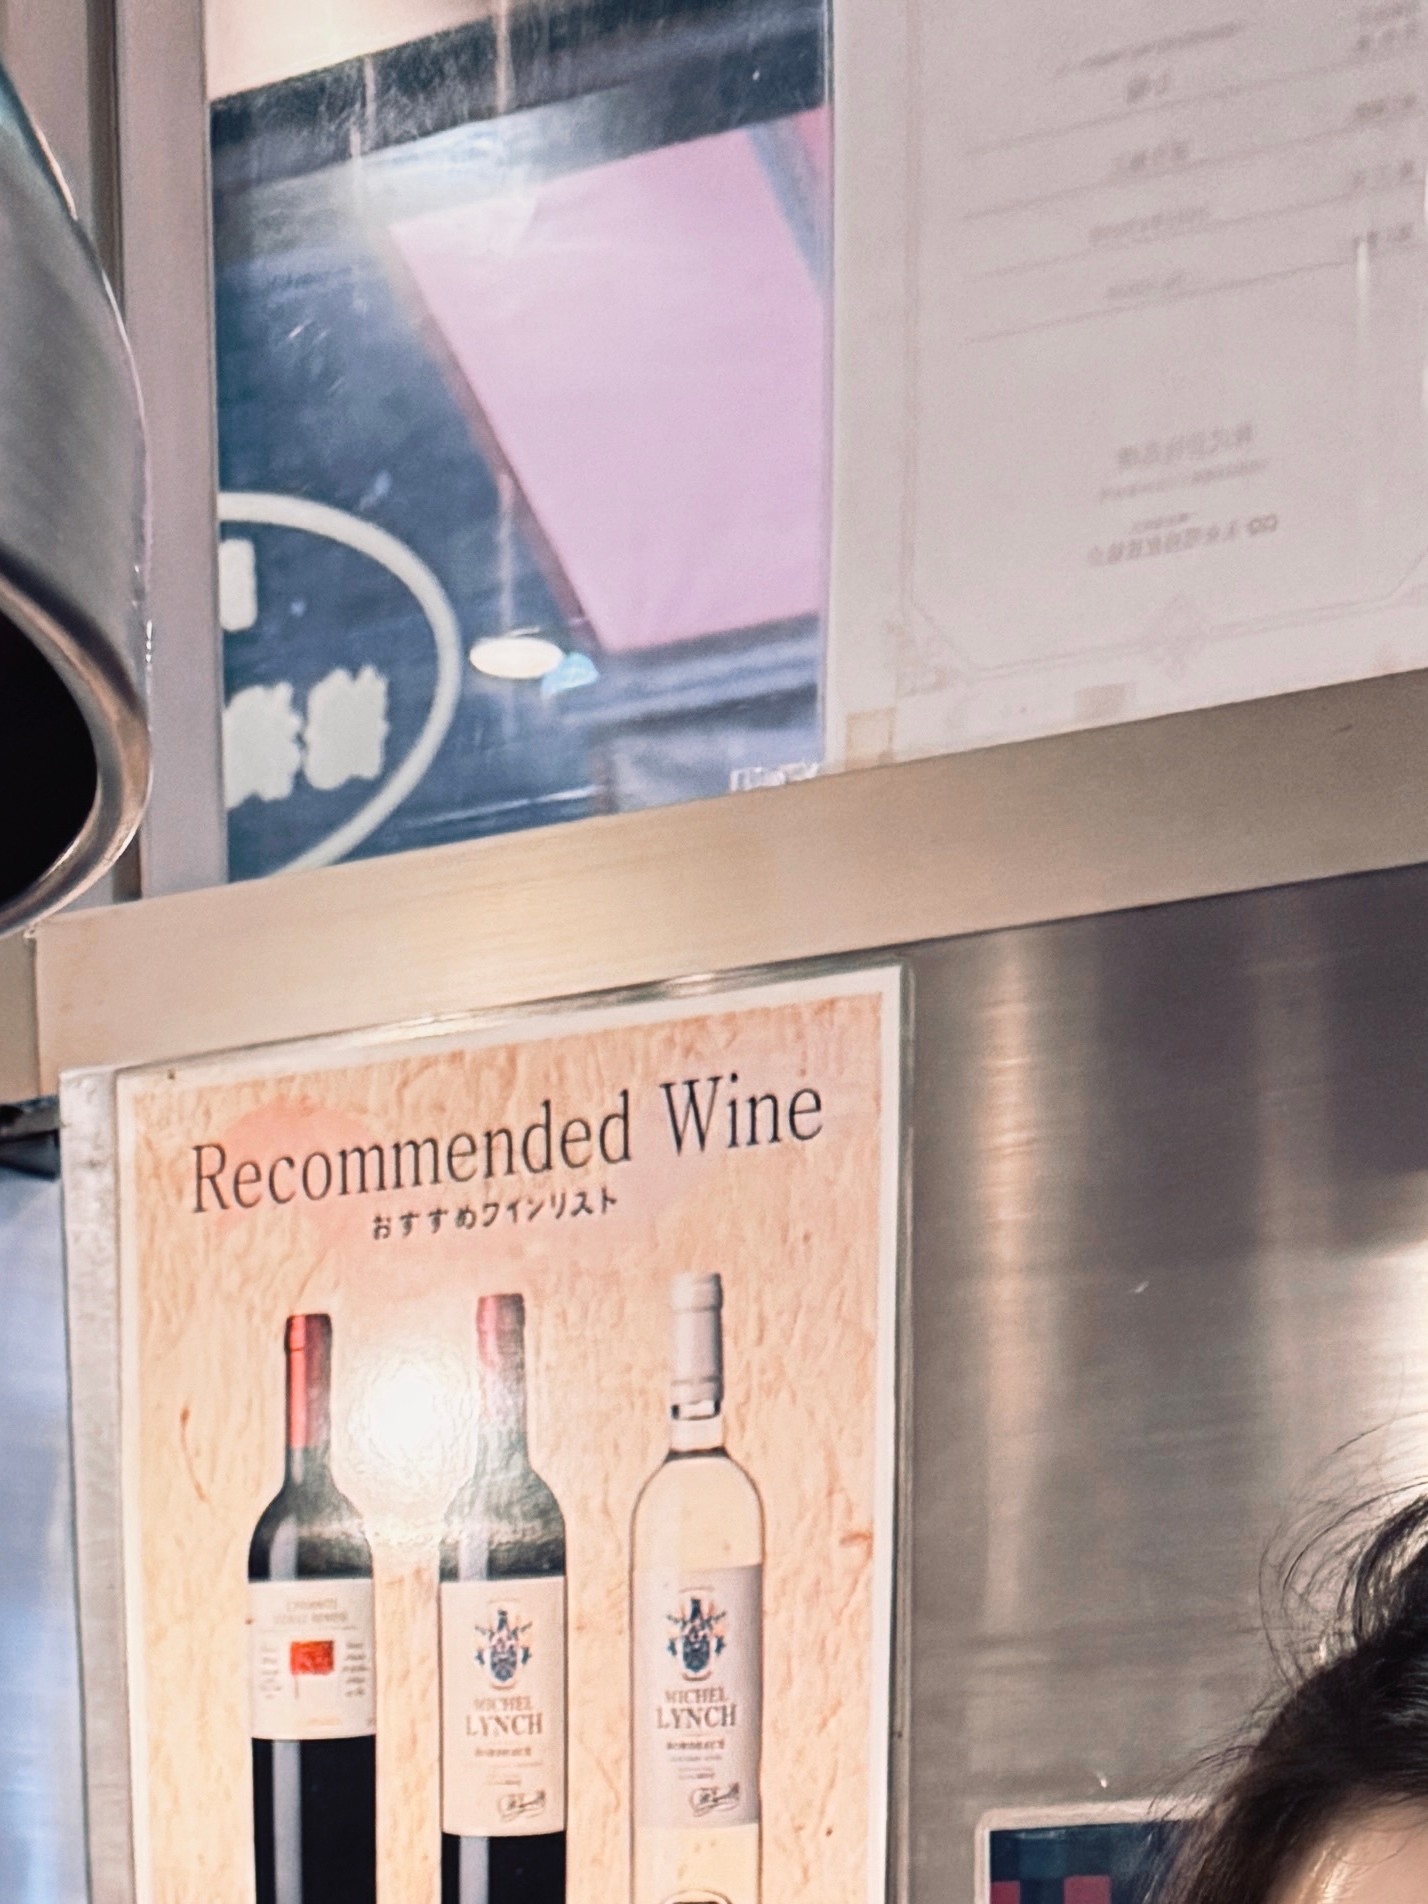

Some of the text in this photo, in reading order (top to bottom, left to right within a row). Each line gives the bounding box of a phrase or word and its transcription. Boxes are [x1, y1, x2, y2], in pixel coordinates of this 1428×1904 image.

[192, 1072, 824, 1213] Recommended Wine
[373, 1186, 619, 1241] おすすめワインリスト
[465, 1712, 543, 1737] LYNCH
[656, 1703, 737, 1730] LYNCH
